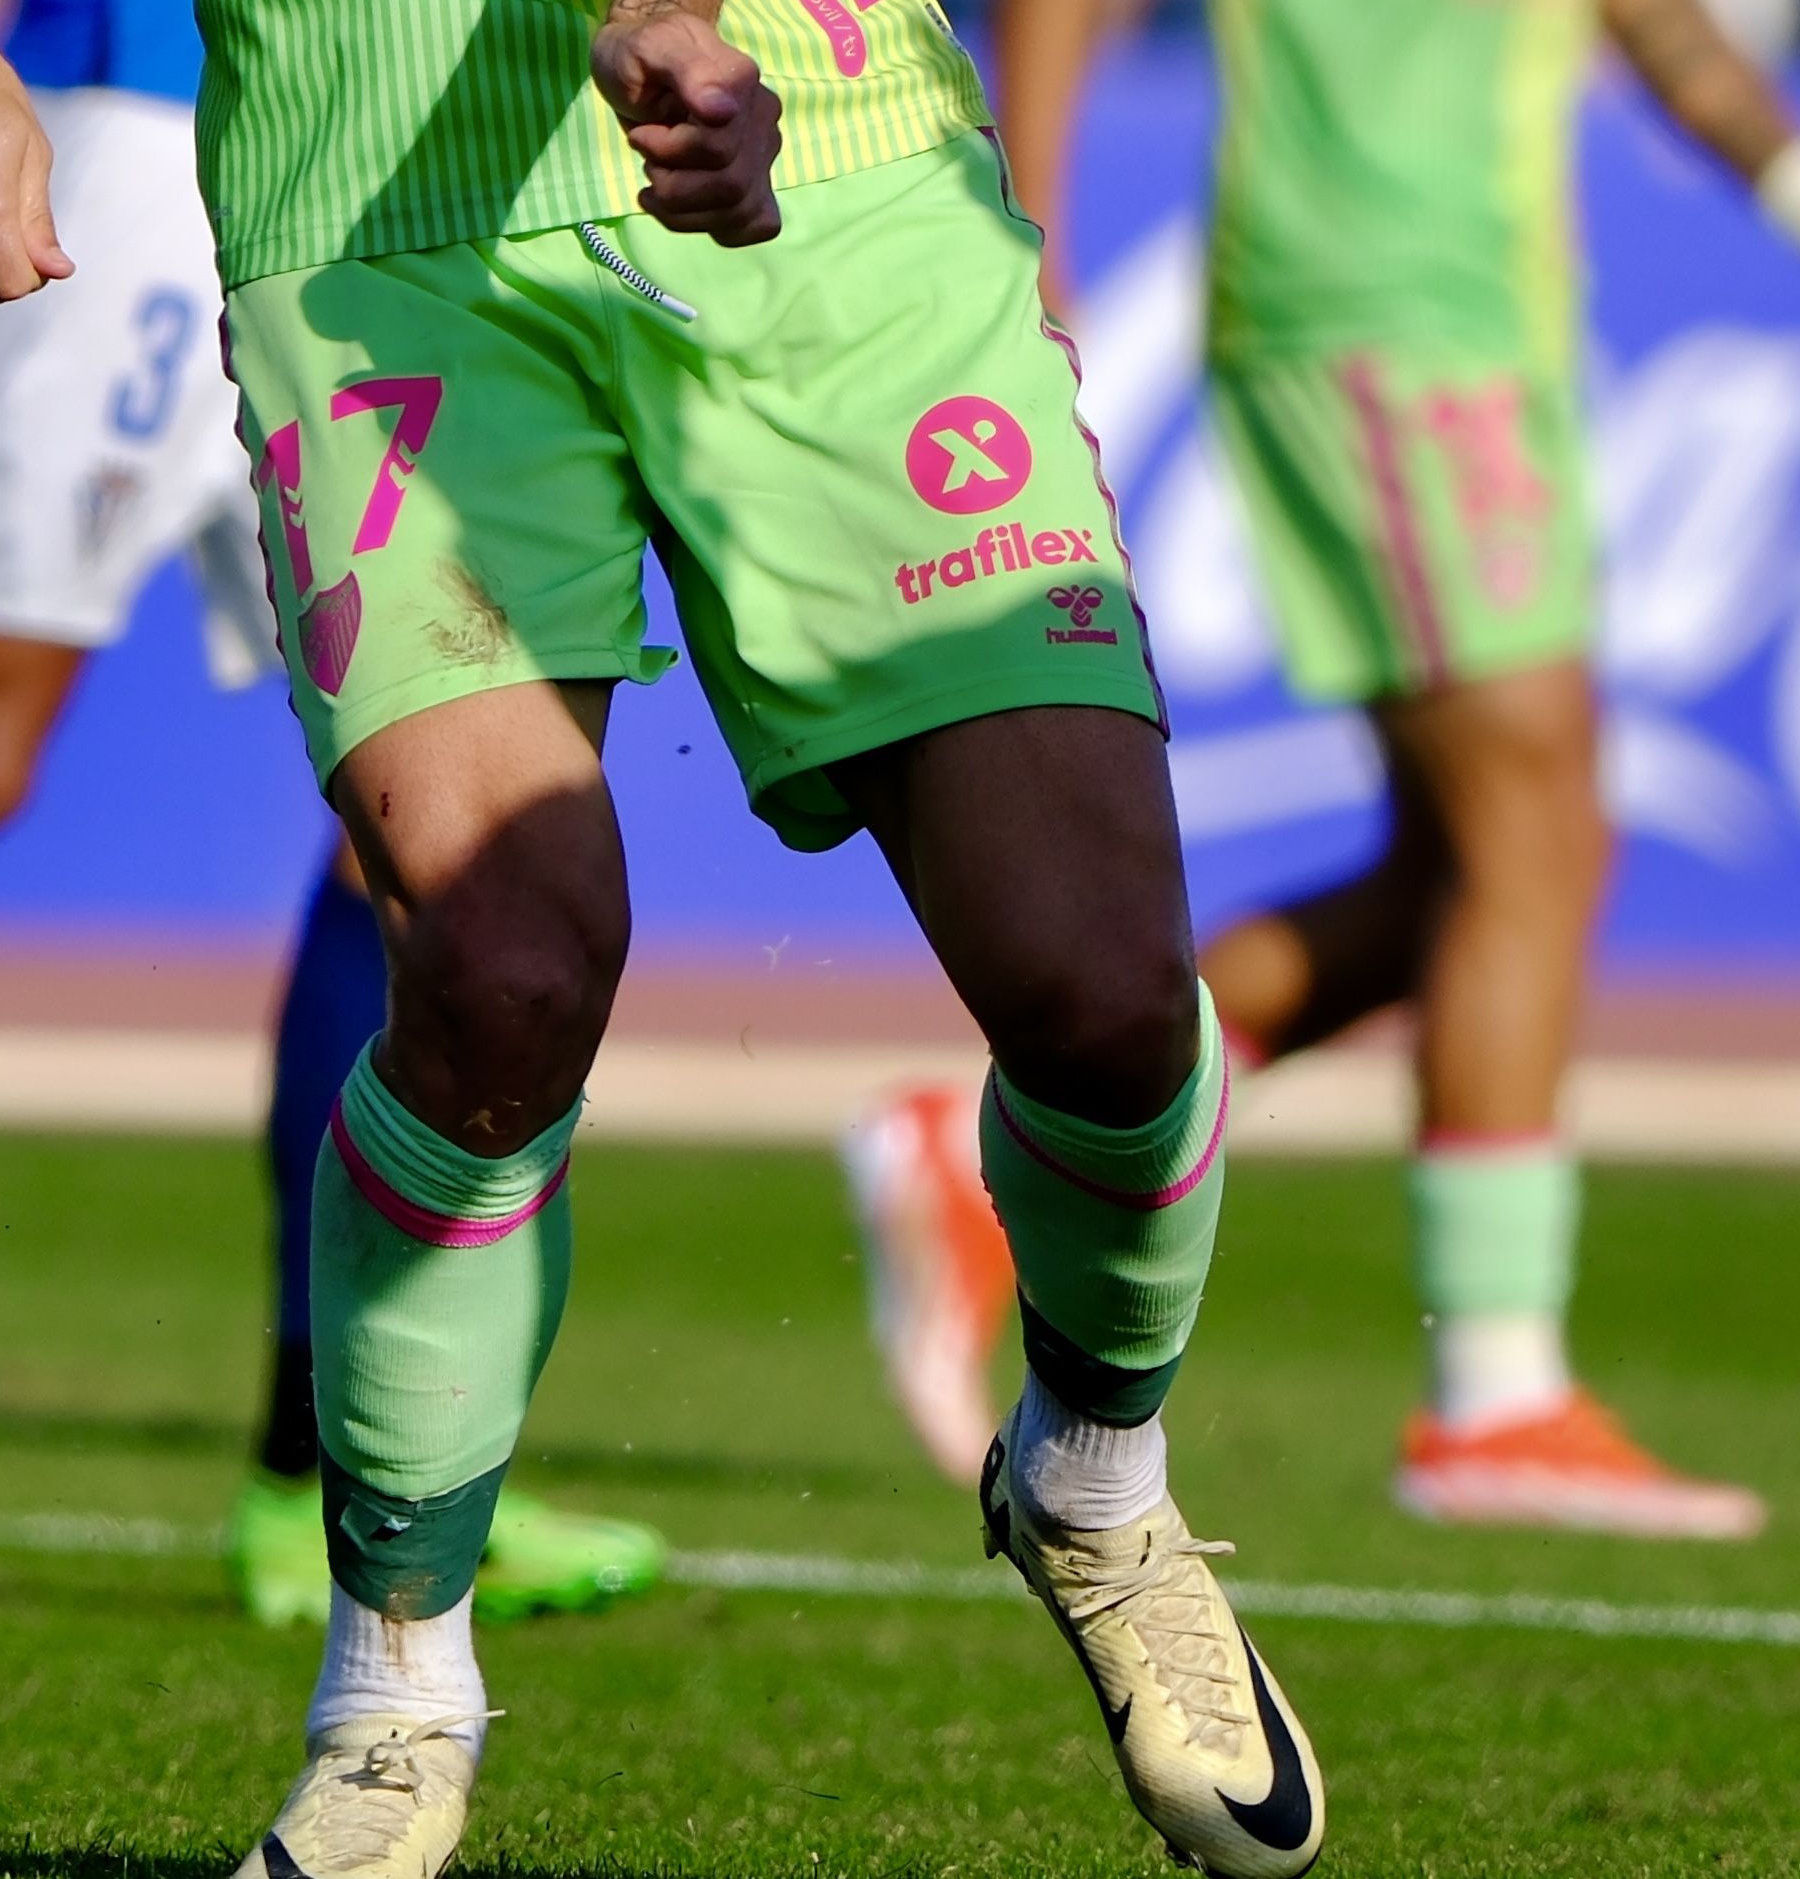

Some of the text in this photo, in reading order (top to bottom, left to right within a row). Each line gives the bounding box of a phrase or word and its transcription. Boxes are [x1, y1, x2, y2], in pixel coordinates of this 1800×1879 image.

[838, 33, 857, 59] tv
[106, 282, 199, 443] 3
[256, 375, 444, 597] 17
[895, 522, 1098, 604] trafilex
[1045, 626, 1118, 645] hummel
